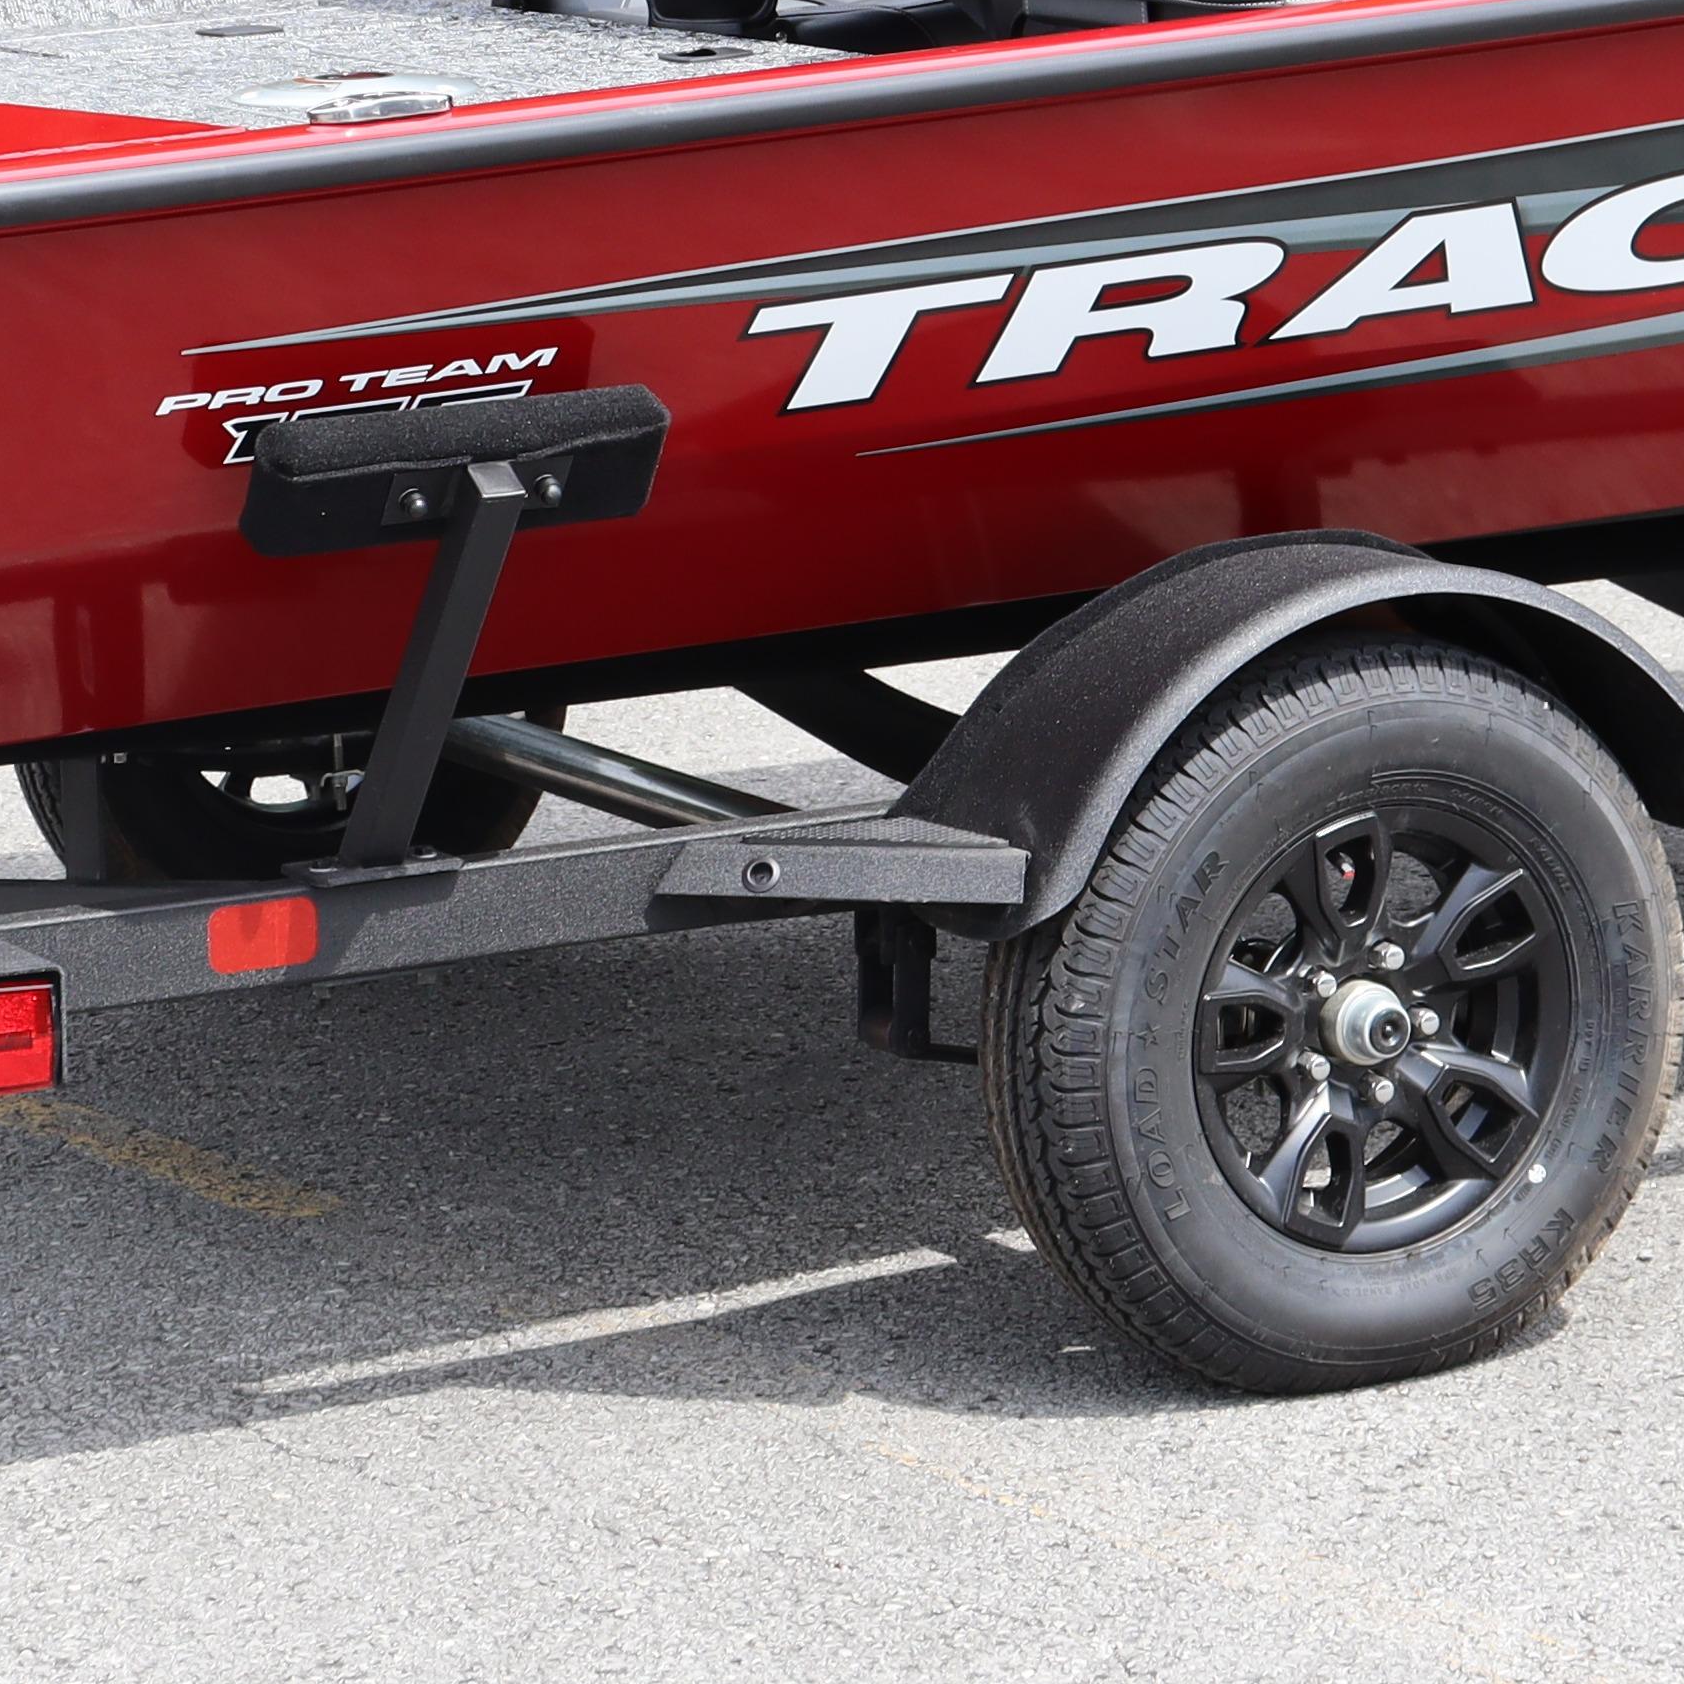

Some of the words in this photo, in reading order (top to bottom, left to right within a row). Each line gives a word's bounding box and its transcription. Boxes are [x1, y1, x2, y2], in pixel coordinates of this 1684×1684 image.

[155, 379, 324, 418] PRO
[339, 347, 560, 394] TEAM
[1144, 849, 1230, 1008] STAR
[1587, 899, 1653, 1174] KARRIER
[1134, 1066, 1193, 1222] LOAD
